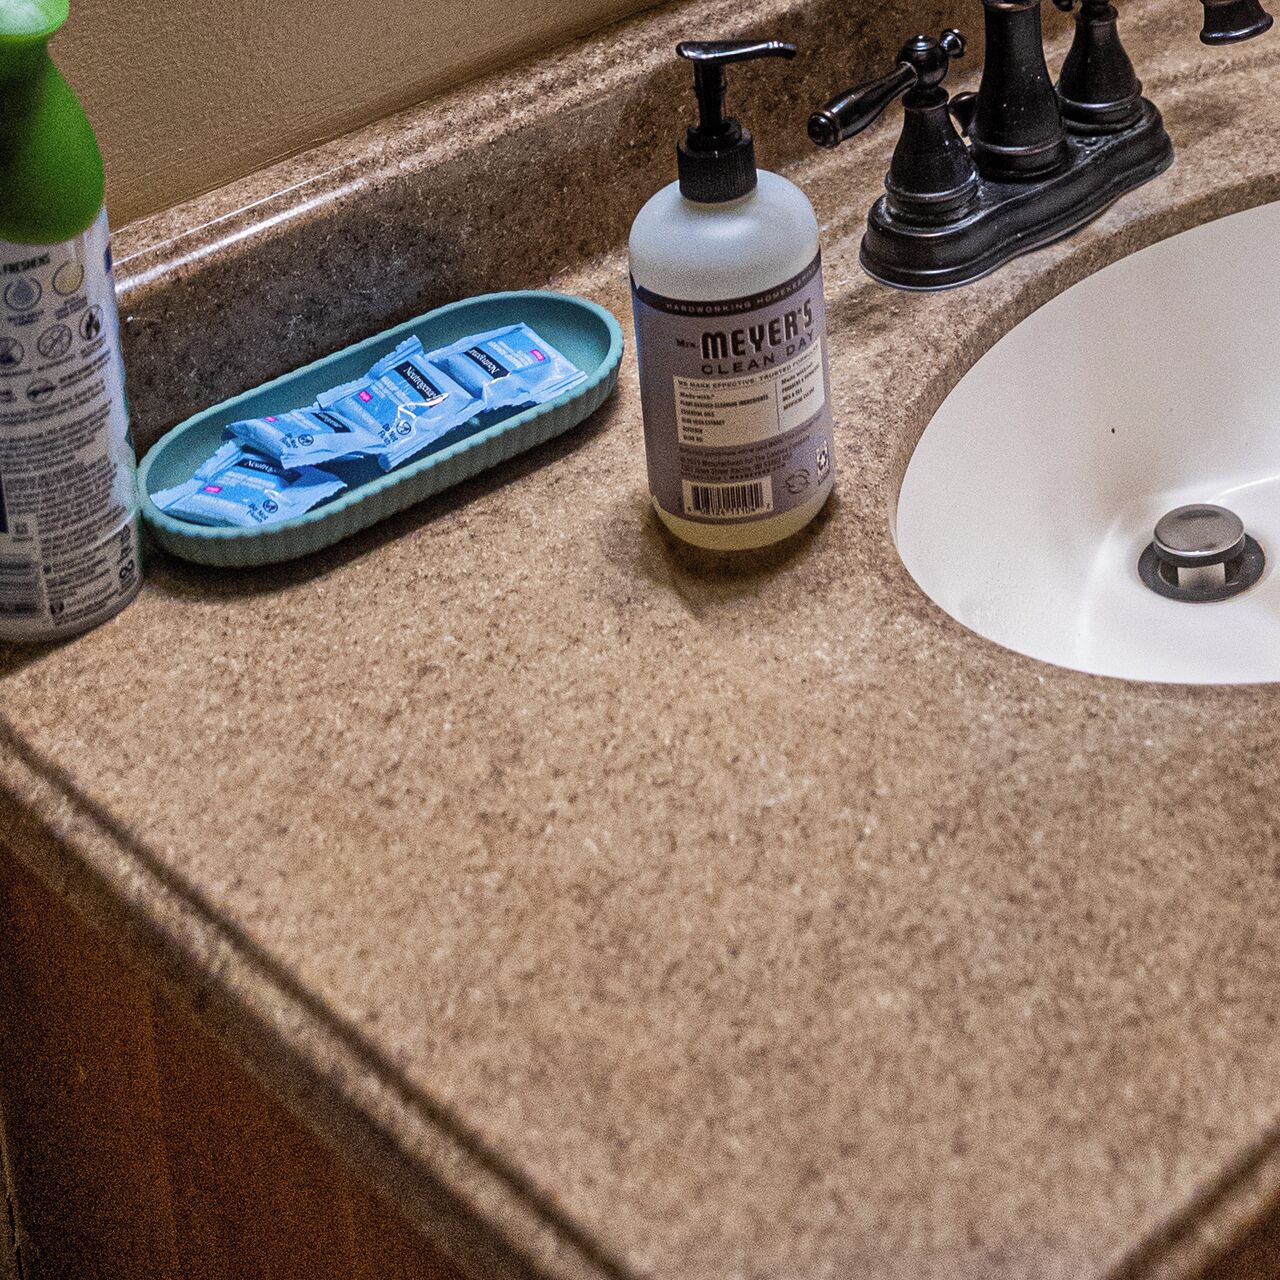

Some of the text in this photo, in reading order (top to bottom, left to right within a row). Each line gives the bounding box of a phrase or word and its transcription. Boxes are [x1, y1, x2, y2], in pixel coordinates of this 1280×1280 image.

[700, 298, 813, 360] MEYER'S
[701, 328, 815, 375] CLEAN DAY
